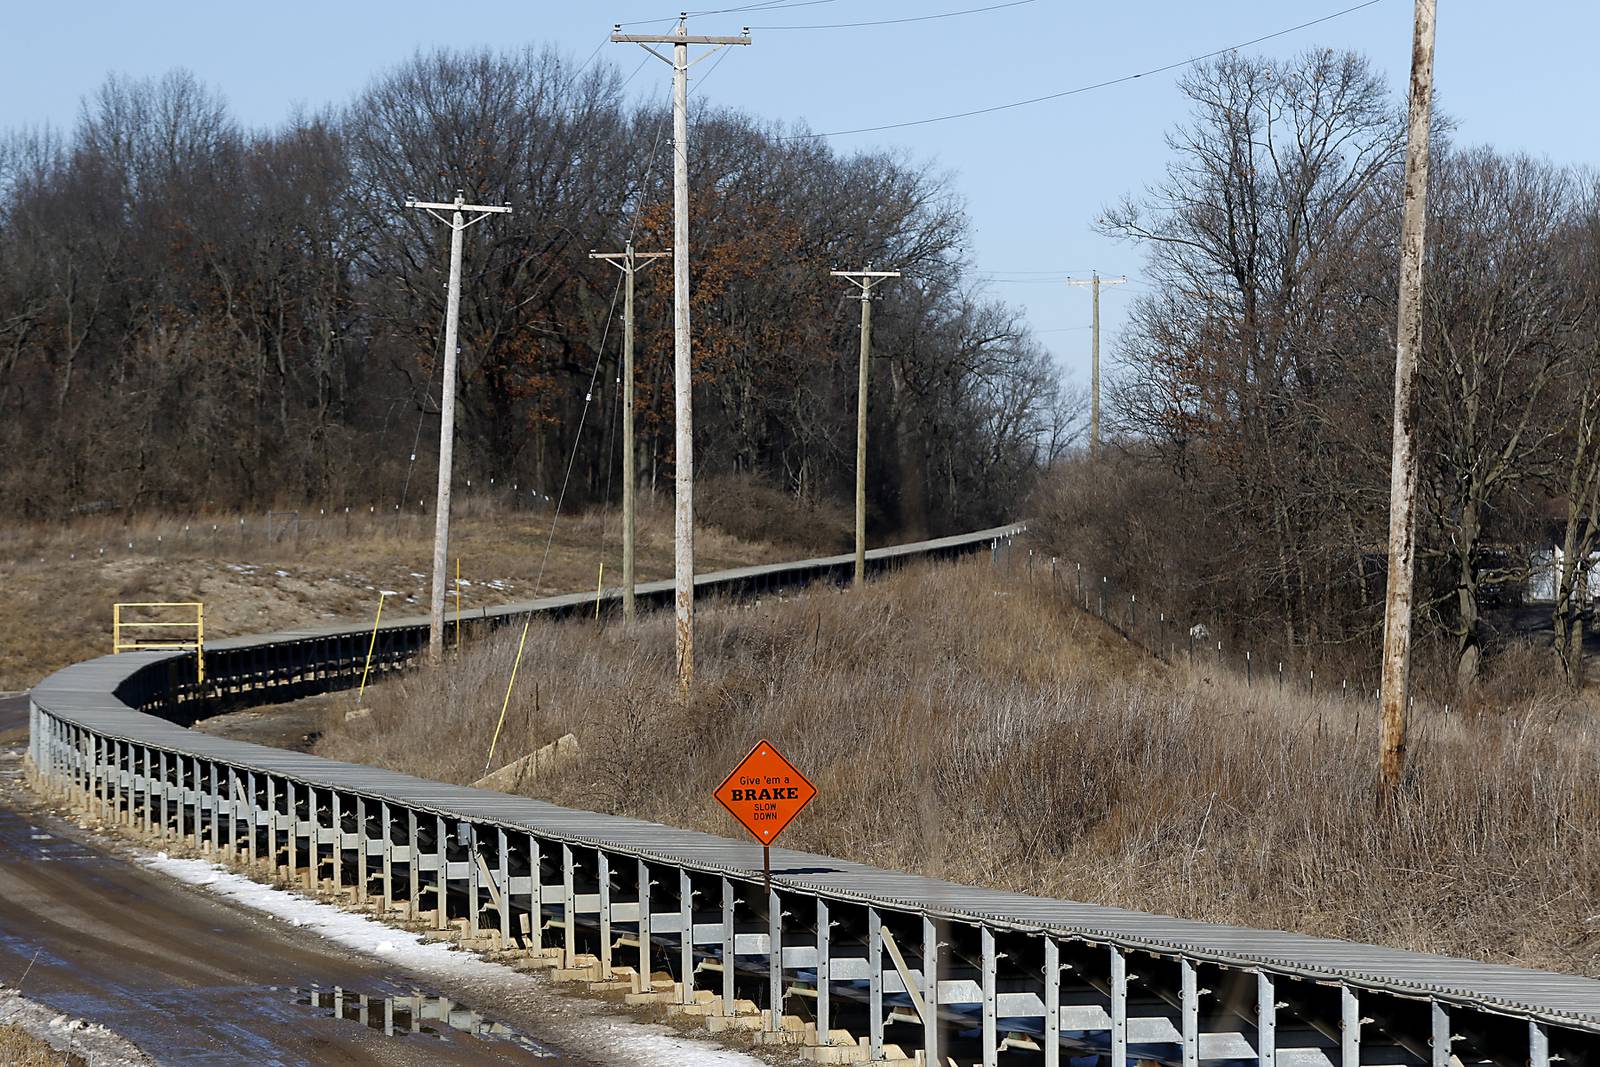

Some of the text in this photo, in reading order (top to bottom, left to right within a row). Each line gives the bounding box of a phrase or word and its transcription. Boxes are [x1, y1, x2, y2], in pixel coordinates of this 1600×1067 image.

[740, 776, 760, 785] Give
[764, 776, 781, 785] 'em
[732, 788, 798, 801] BRAKE
[754, 803, 776, 811] SLOW
[754, 812, 777, 820] DOWN
